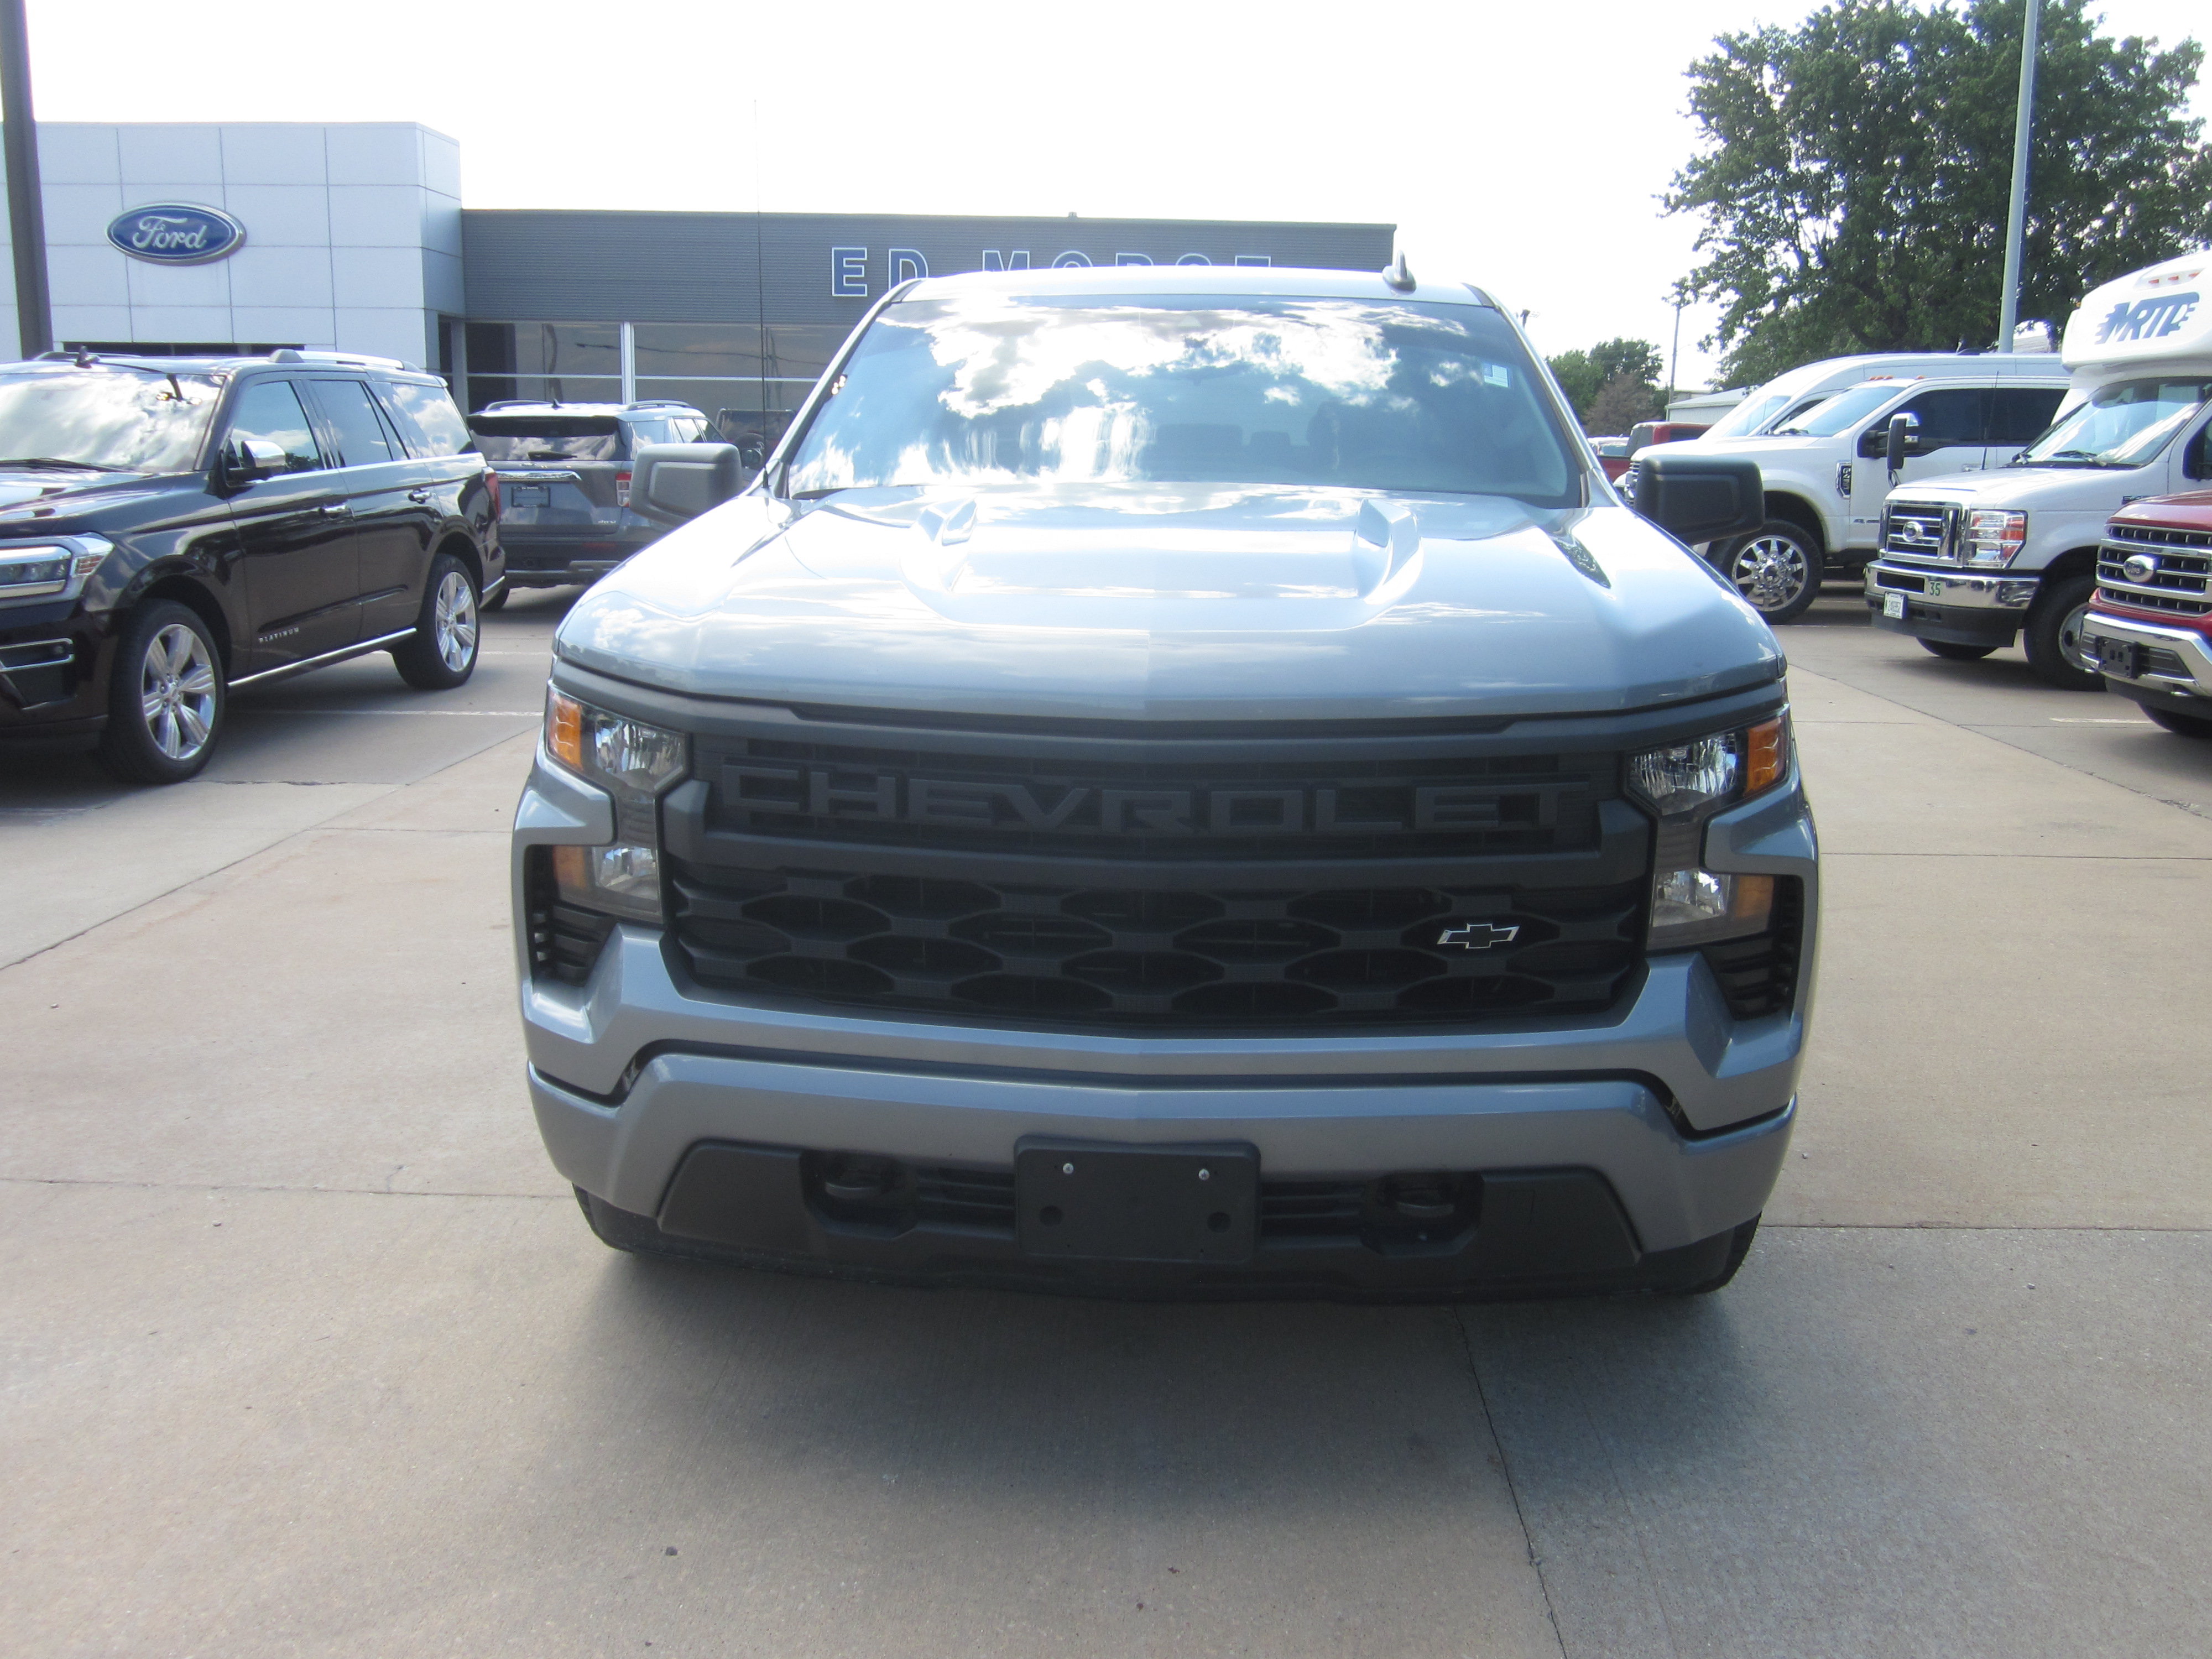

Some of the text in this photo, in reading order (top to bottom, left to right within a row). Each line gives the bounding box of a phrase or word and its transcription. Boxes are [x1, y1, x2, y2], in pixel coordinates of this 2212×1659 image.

[132, 215, 208, 249] Ford
[831, 247, 930, 297] ED
[1929, 582, 1941, 597] 35
[258, 627, 299, 644] PLATINUM
[722, 762, 1589, 834] CHEVROLET
